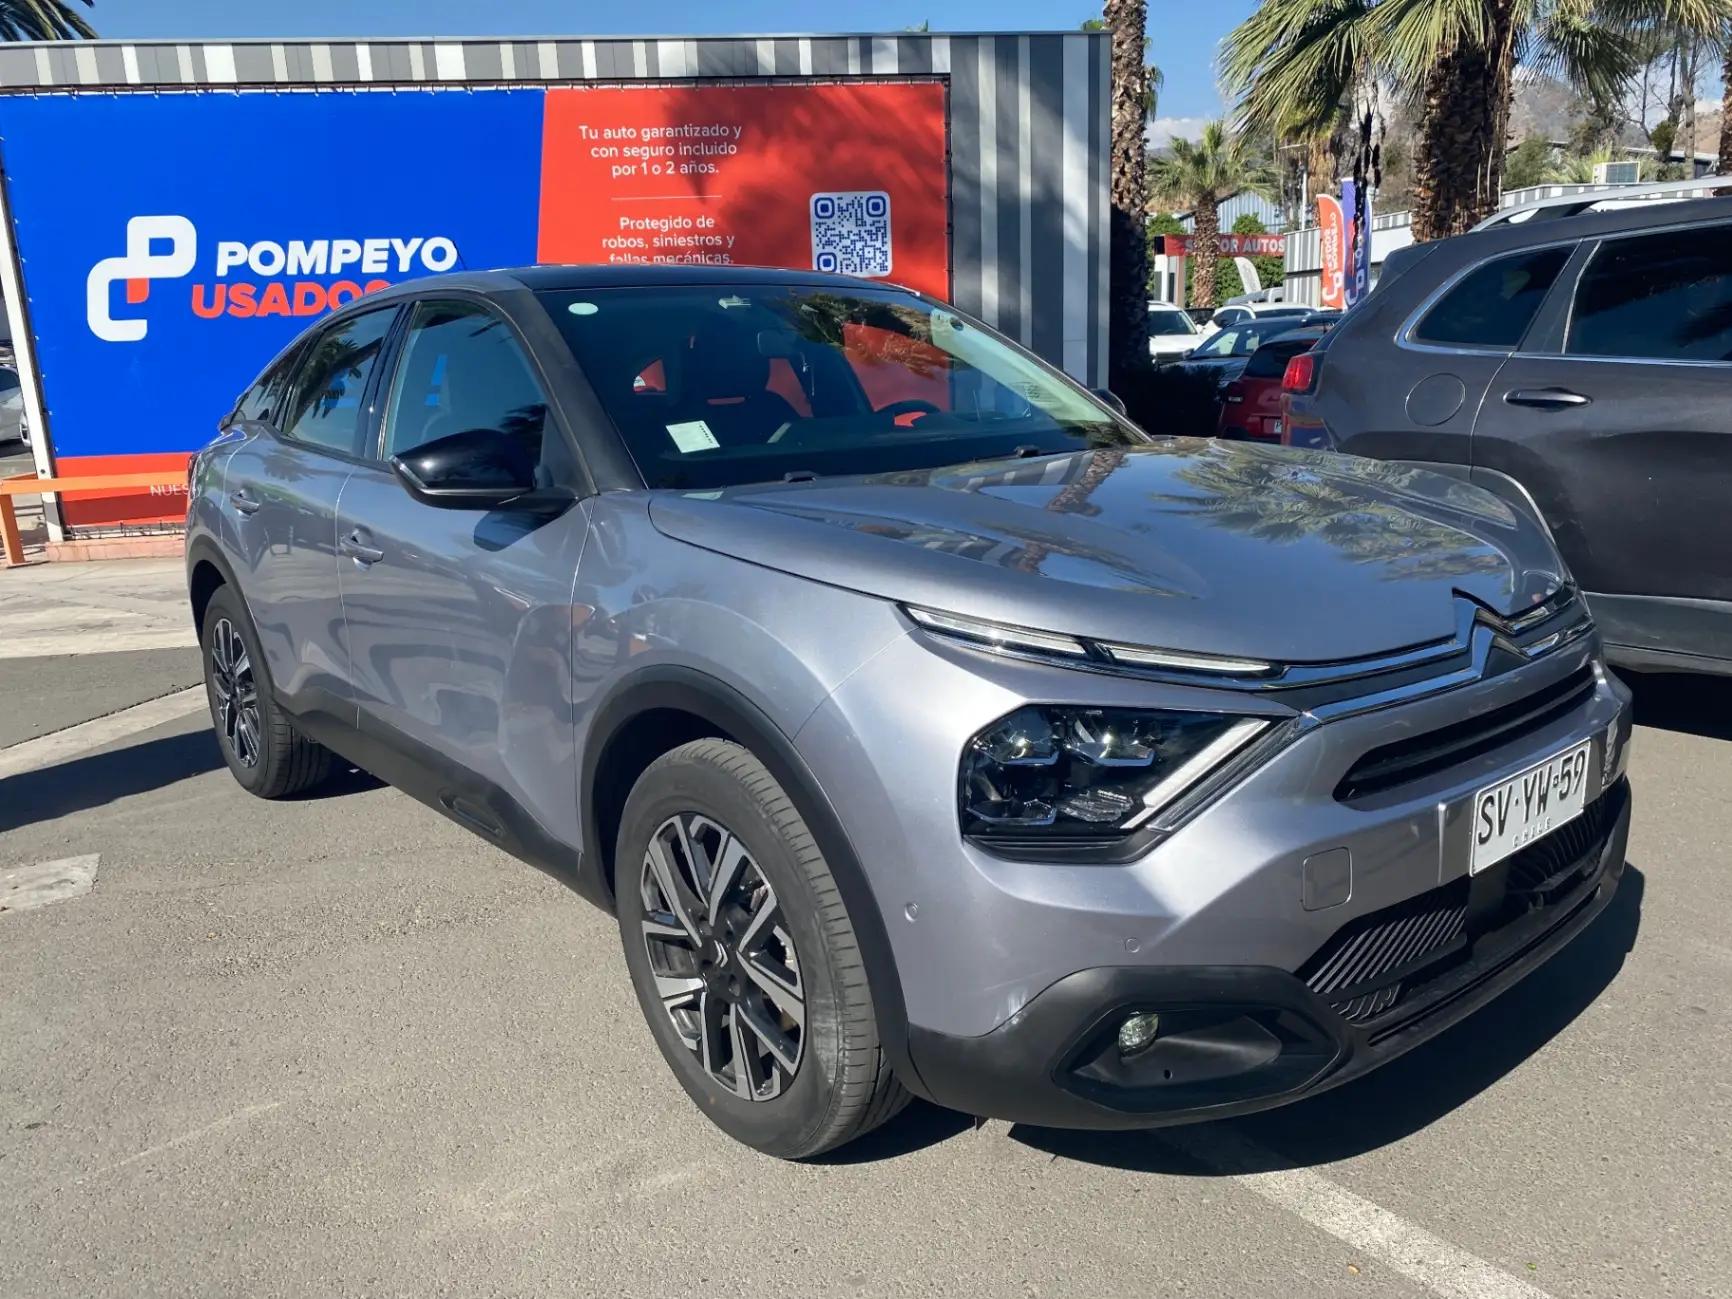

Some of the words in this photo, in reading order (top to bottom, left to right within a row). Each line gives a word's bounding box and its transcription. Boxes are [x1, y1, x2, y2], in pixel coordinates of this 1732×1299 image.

[579, 125, 599, 139] Tu
[603, 126, 637, 139] auto
[641, 124, 729, 141] garantizado
[733, 126, 742, 139] y
[591, 146, 618, 158] con
[623, 145, 674, 160] seguro
[679, 142, 737, 156] incluido
[612, 164, 636, 179] por
[640, 162, 648, 175] 1
[652, 165, 661, 175] o
[665, 161, 675, 175] 2
[680, 160, 719, 174] años.
[619, 216, 692, 233] Protegido
[696, 215, 715, 228] de
[602, 235, 649, 249] robos,
[653, 234, 722, 248] siniestros
[726, 235, 735, 248] y
[1243, 239, 1285, 253] AUTOS
[216, 237, 458, 277] POMPEYO
[653, 250, 735, 265] mecánicas.
